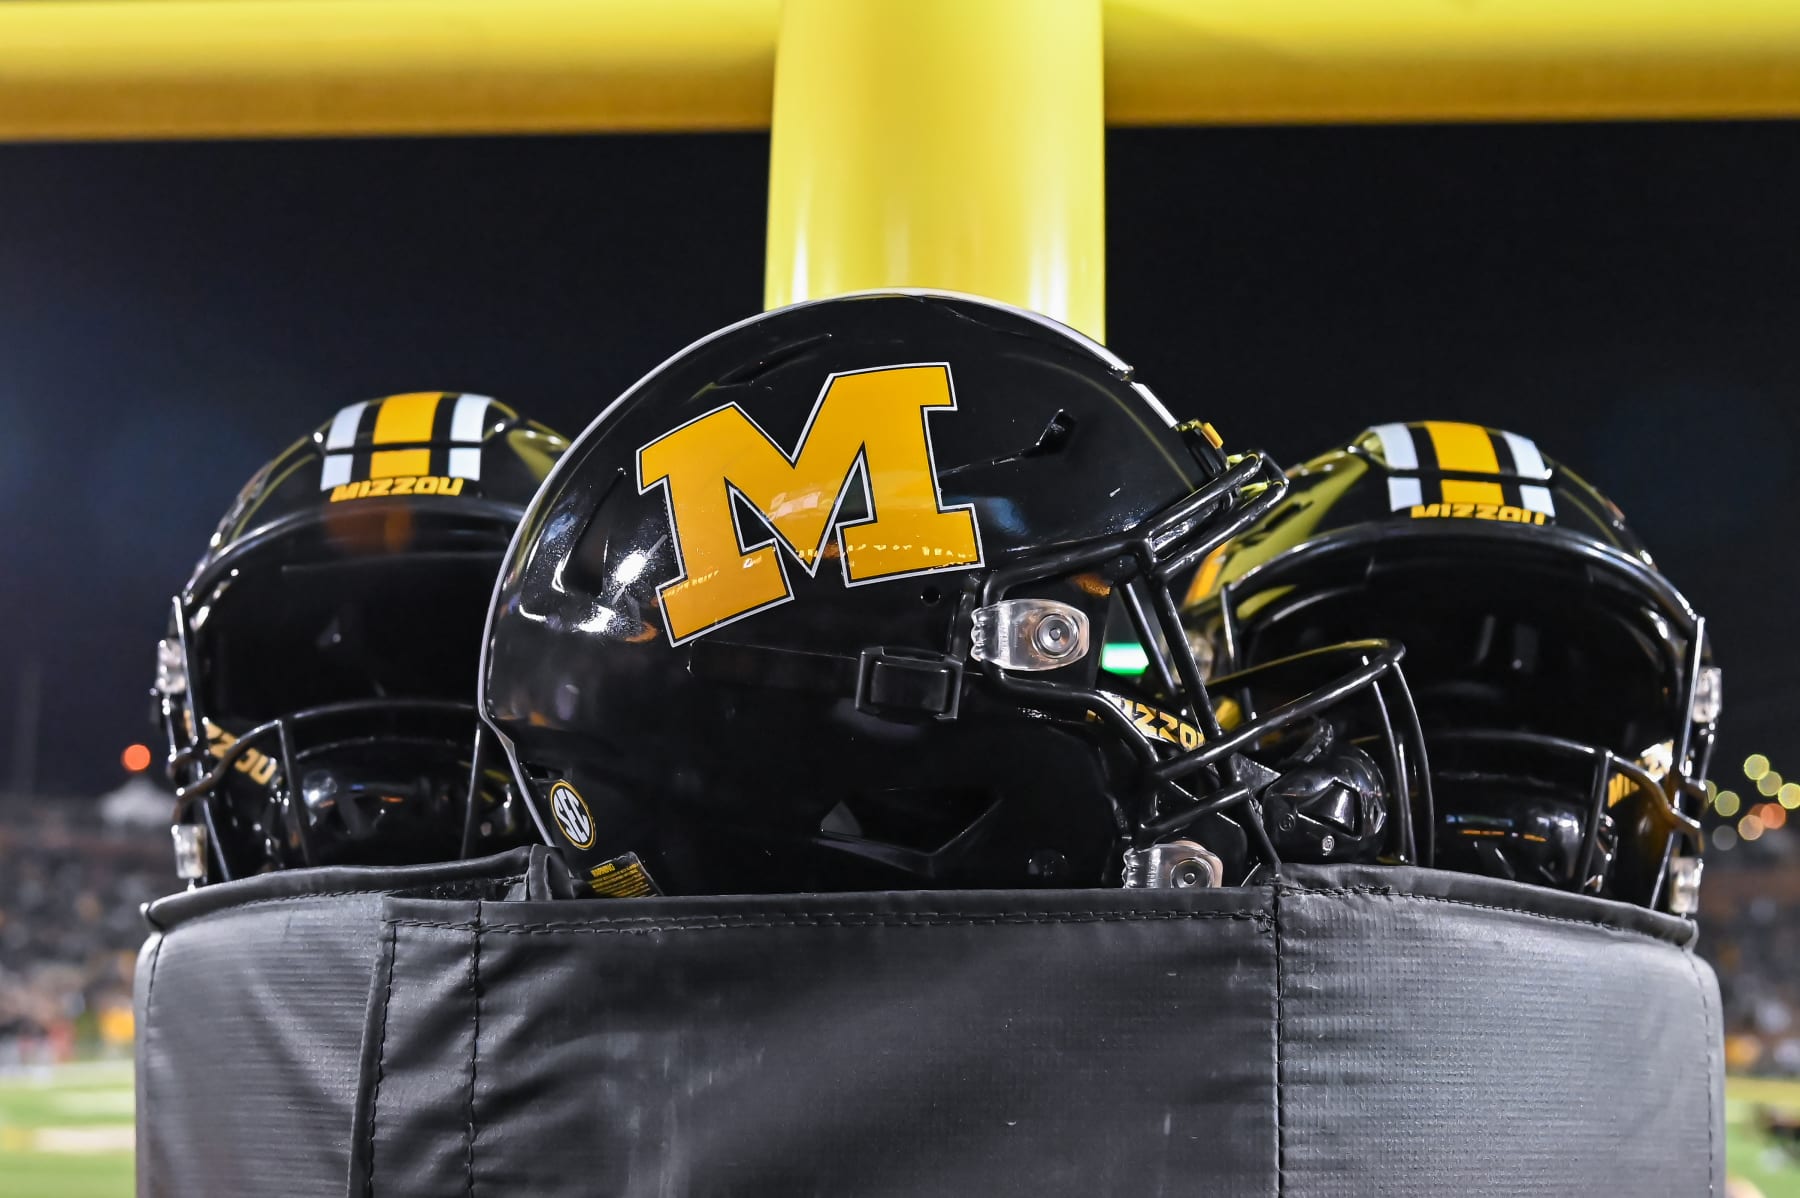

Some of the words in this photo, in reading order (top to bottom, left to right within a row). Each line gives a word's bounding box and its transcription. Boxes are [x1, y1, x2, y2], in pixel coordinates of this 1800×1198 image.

[330, 476, 464, 502] MIZZOU
[636, 362, 985, 647] M
[1410, 503, 1546, 526] MIZZOU
[553, 787, 591, 843] SEC
